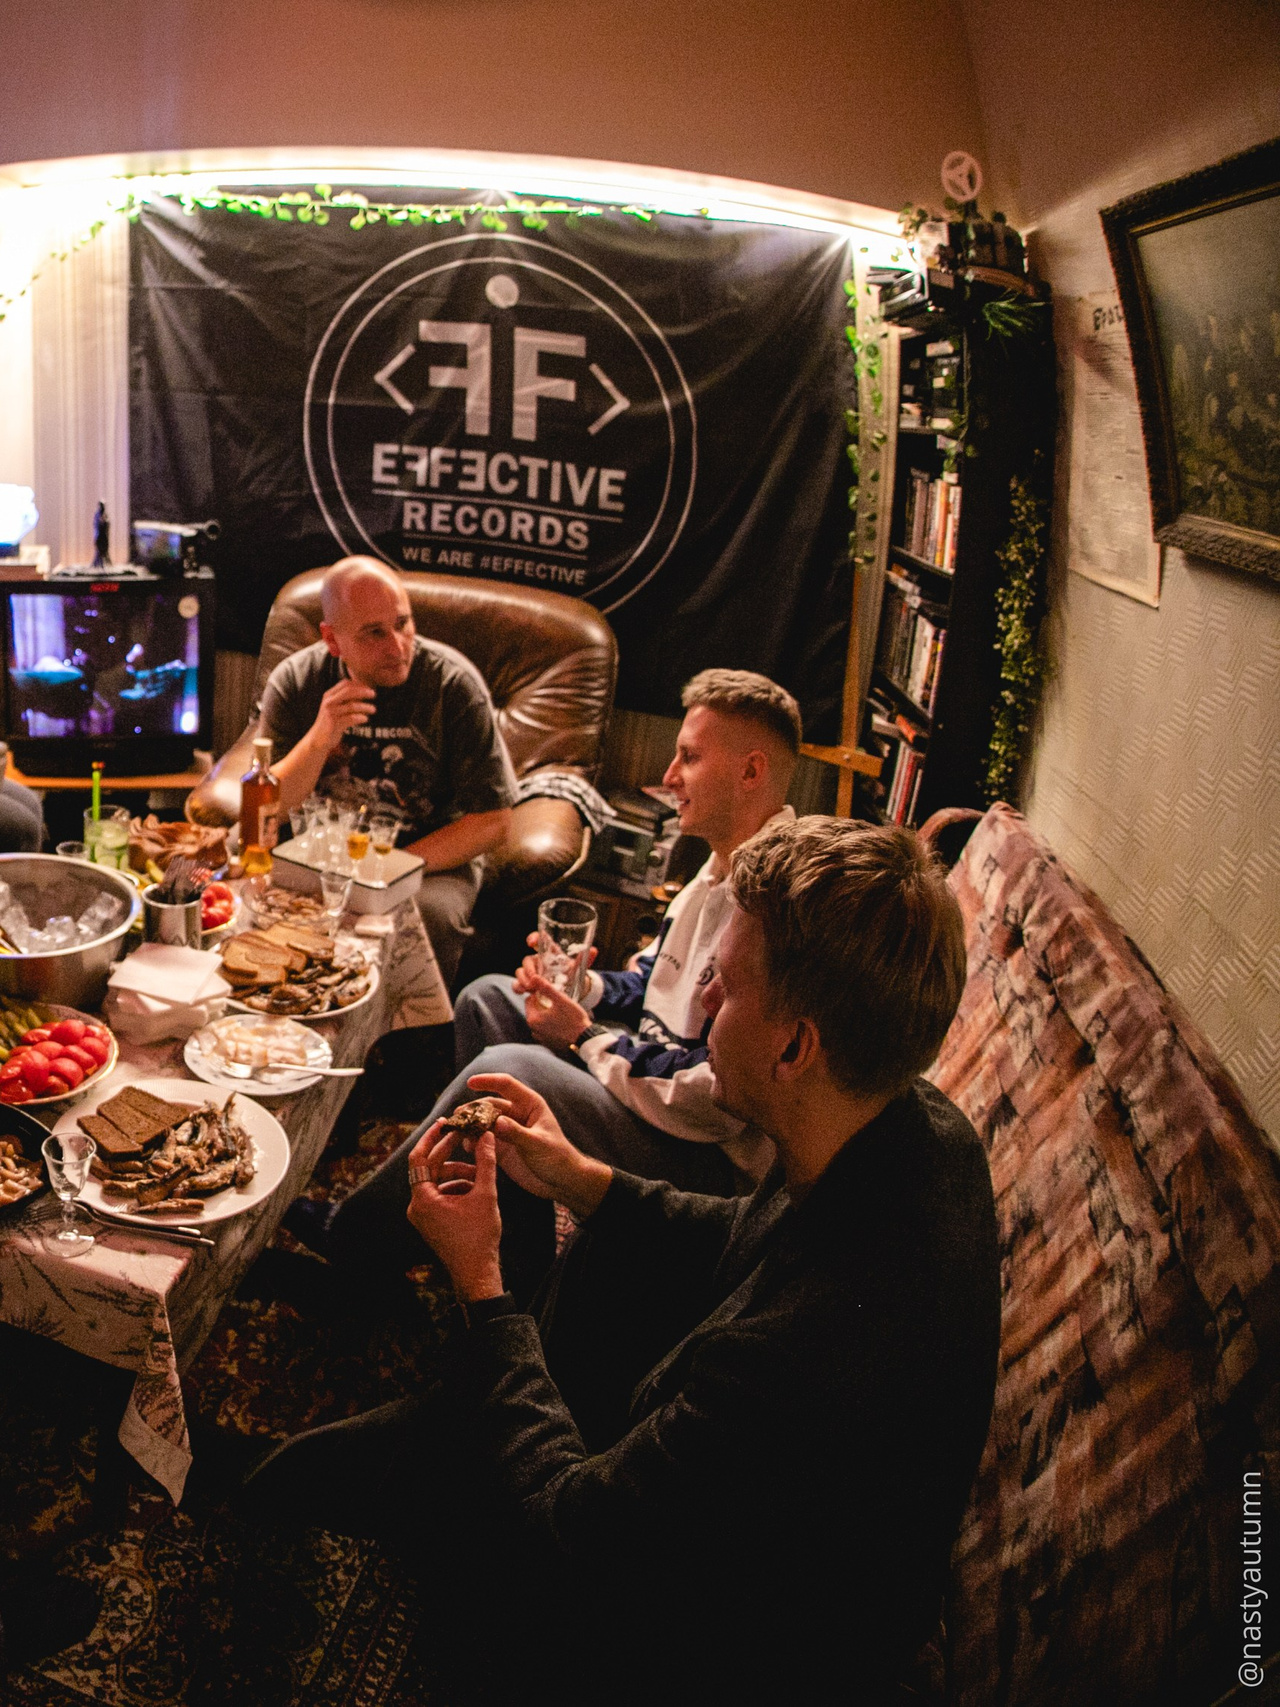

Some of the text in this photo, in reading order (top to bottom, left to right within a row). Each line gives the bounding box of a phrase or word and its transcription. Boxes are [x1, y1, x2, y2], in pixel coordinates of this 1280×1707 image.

[372, 442, 627, 512] EFFECTIVE
[402, 500, 590, 550] RECORDS
[402, 546, 587, 586] WE ARE #EFFECTIVE
